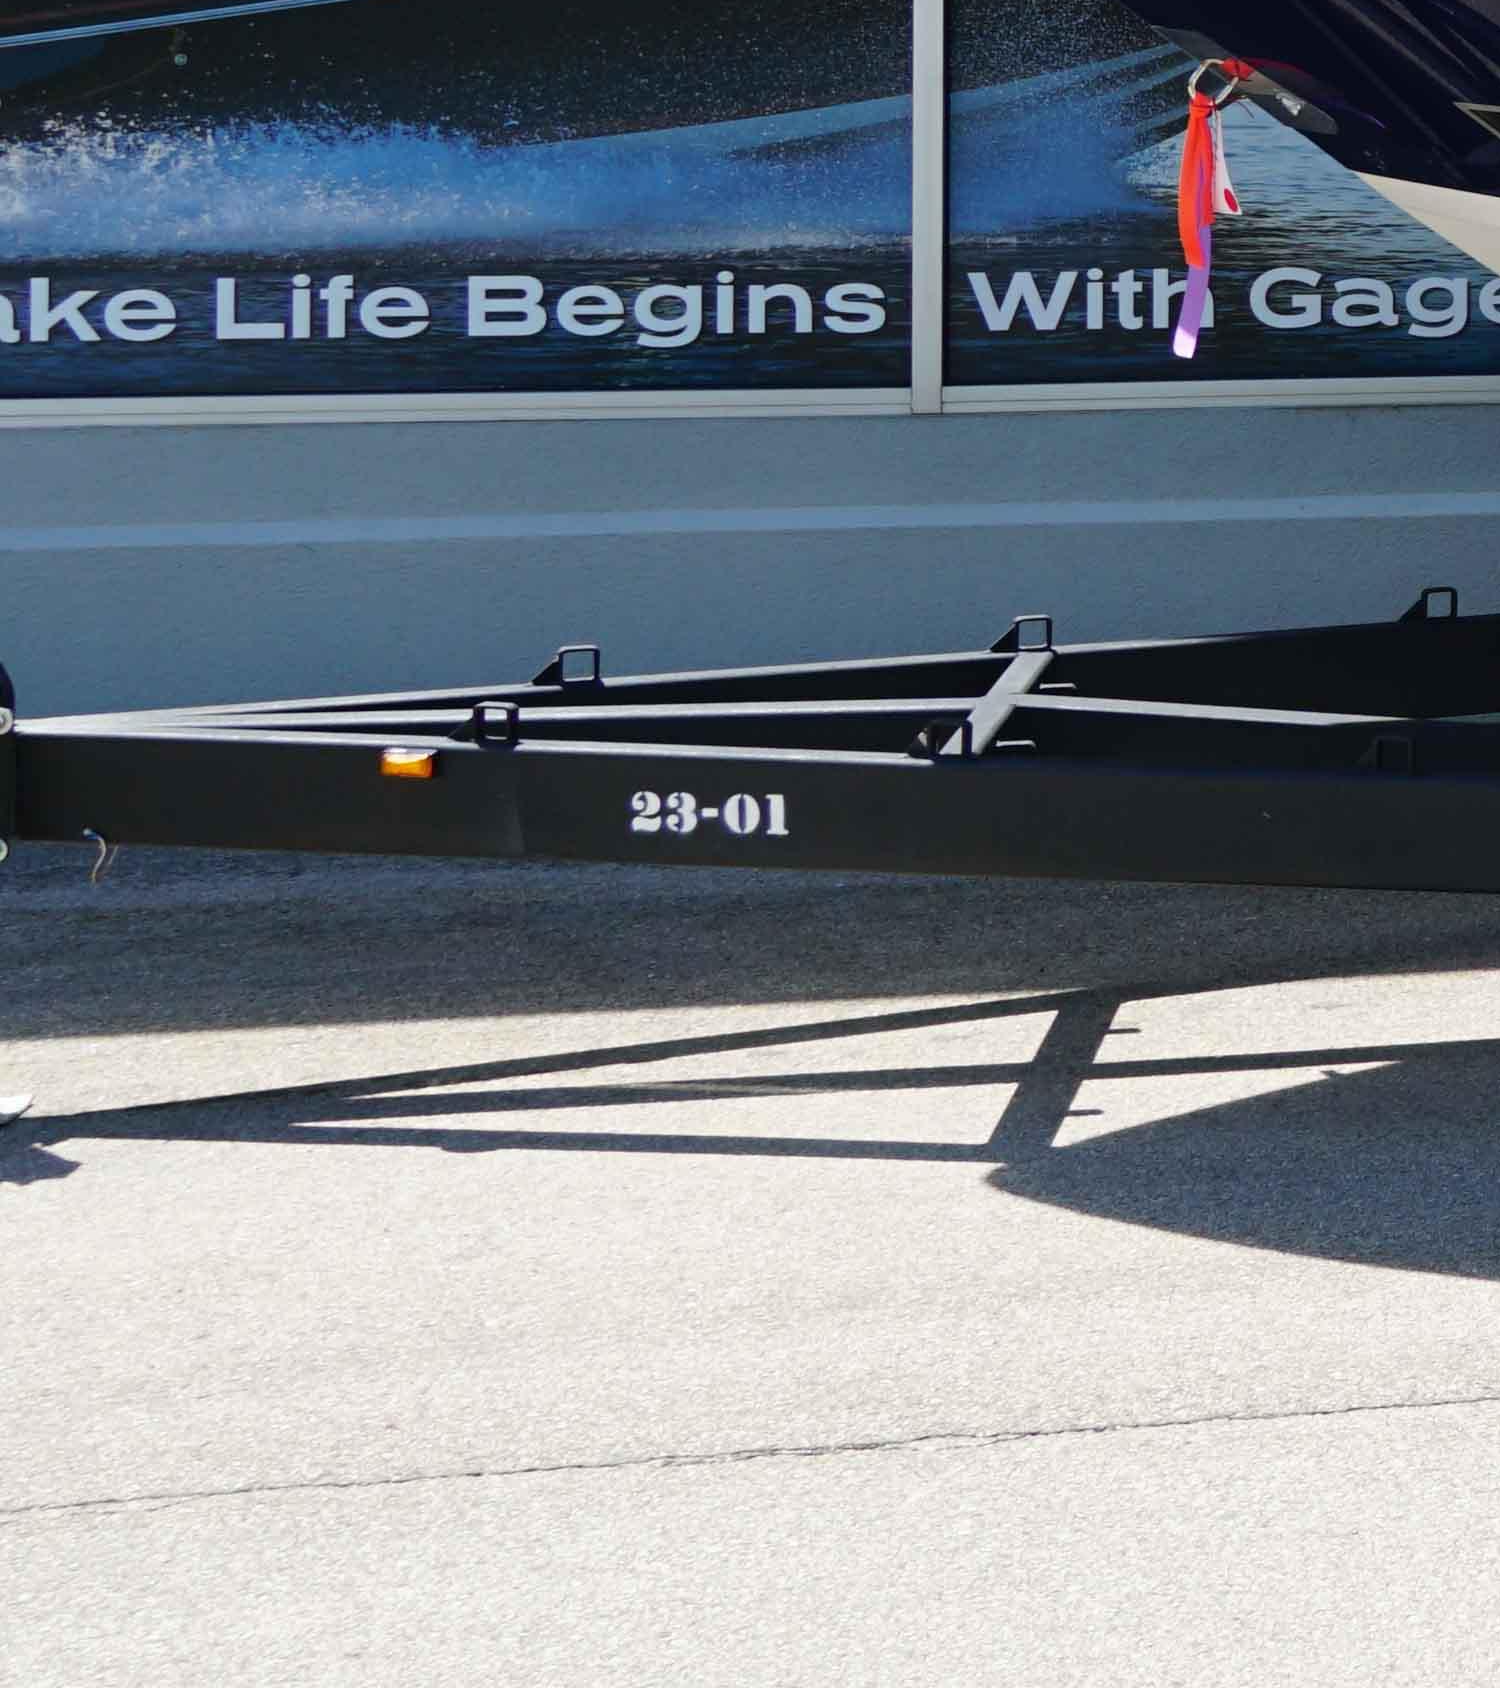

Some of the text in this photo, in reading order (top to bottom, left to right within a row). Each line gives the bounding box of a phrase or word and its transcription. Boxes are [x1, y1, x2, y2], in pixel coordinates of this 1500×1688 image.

[216, 274, 430, 340] Life
[467, 270, 886, 348] Begins
[968, 268, 1215, 331] With
[631, 791, 790, 835] 23-01
